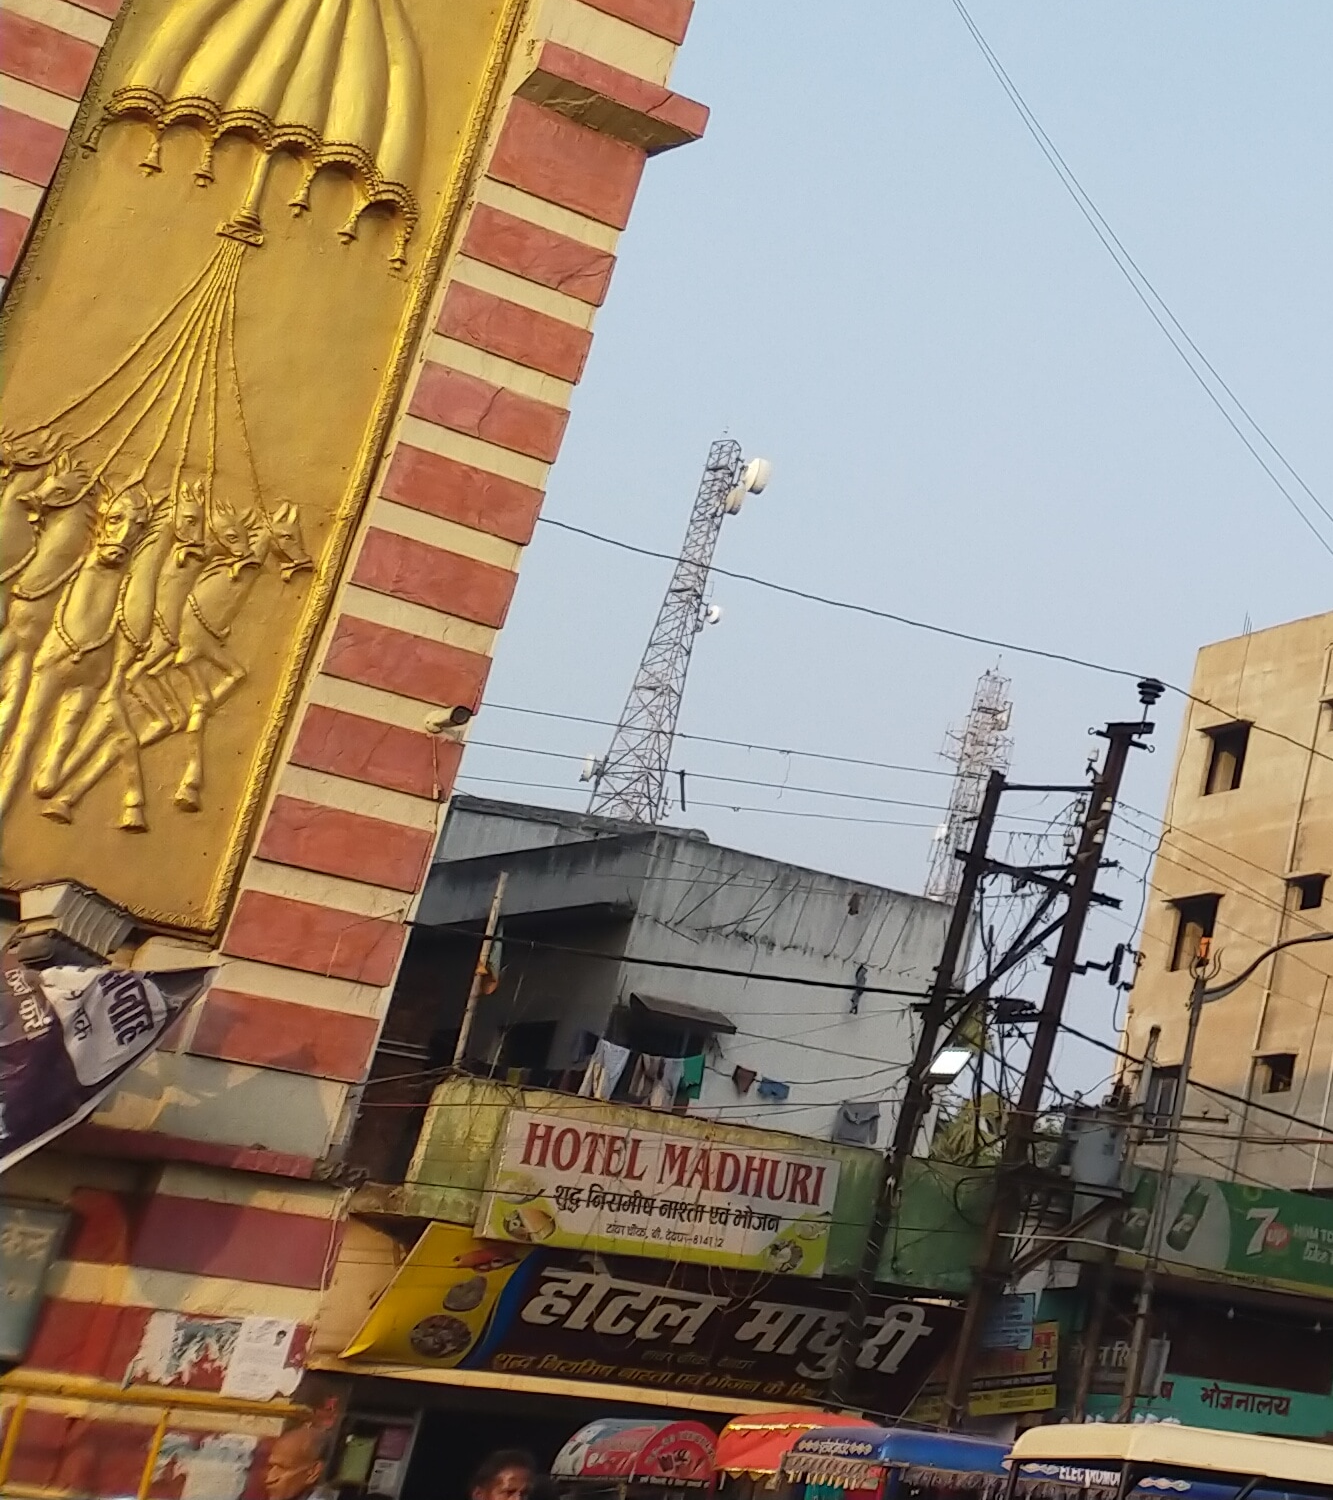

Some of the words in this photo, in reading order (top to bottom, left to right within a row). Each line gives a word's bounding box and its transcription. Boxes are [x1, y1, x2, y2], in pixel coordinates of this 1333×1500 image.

[520, 1122, 650, 1182] HOTEL
[657, 1142, 828, 1207] MADHURI
[732, 1203, 783, 1233] भोजन
[520, 1256, 732, 1345] होटल
[735, 1300, 934, 1380] माधुरी
[1200, 1382, 1293, 1416] भोजनालय
